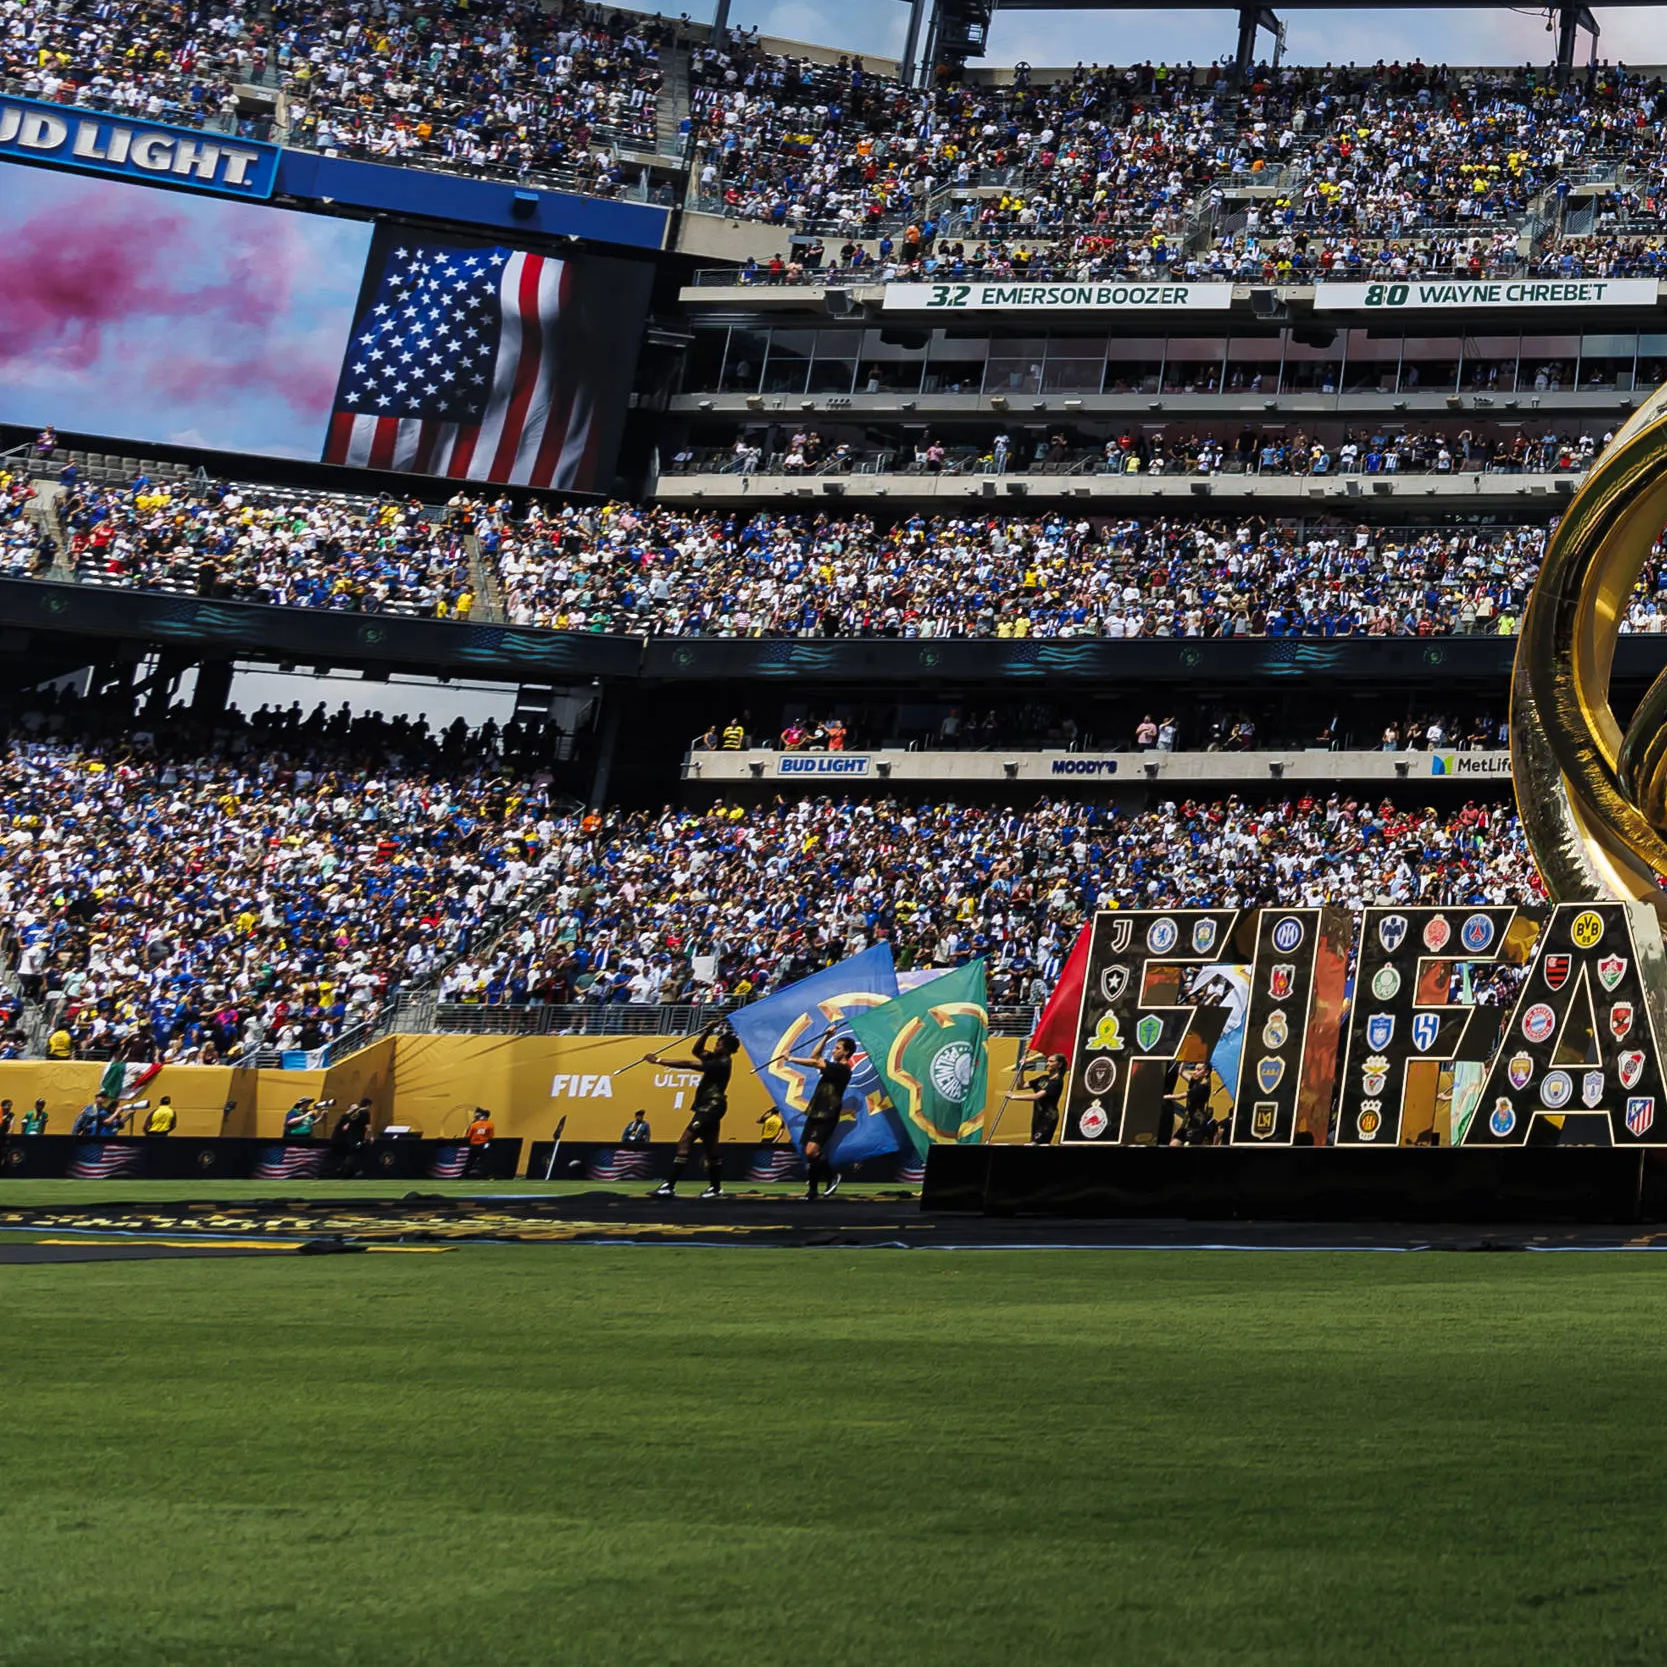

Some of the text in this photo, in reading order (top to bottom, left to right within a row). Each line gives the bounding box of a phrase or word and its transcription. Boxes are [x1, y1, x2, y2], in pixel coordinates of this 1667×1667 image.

[72, 119, 258, 185] LIGHT
[926, 286, 1188, 307] 32 EMERSON BOOZER
[1365, 283, 1607, 306] 80 WAYNE CHREBET
[780, 756, 869, 774] BUD LIGHT
[1052, 760, 1118, 775] MOODY'S
[1577, 915, 1599, 936] BVB
[551, 1074, 613, 1098] FIFA
[654, 1073, 701, 1087] ULTR
